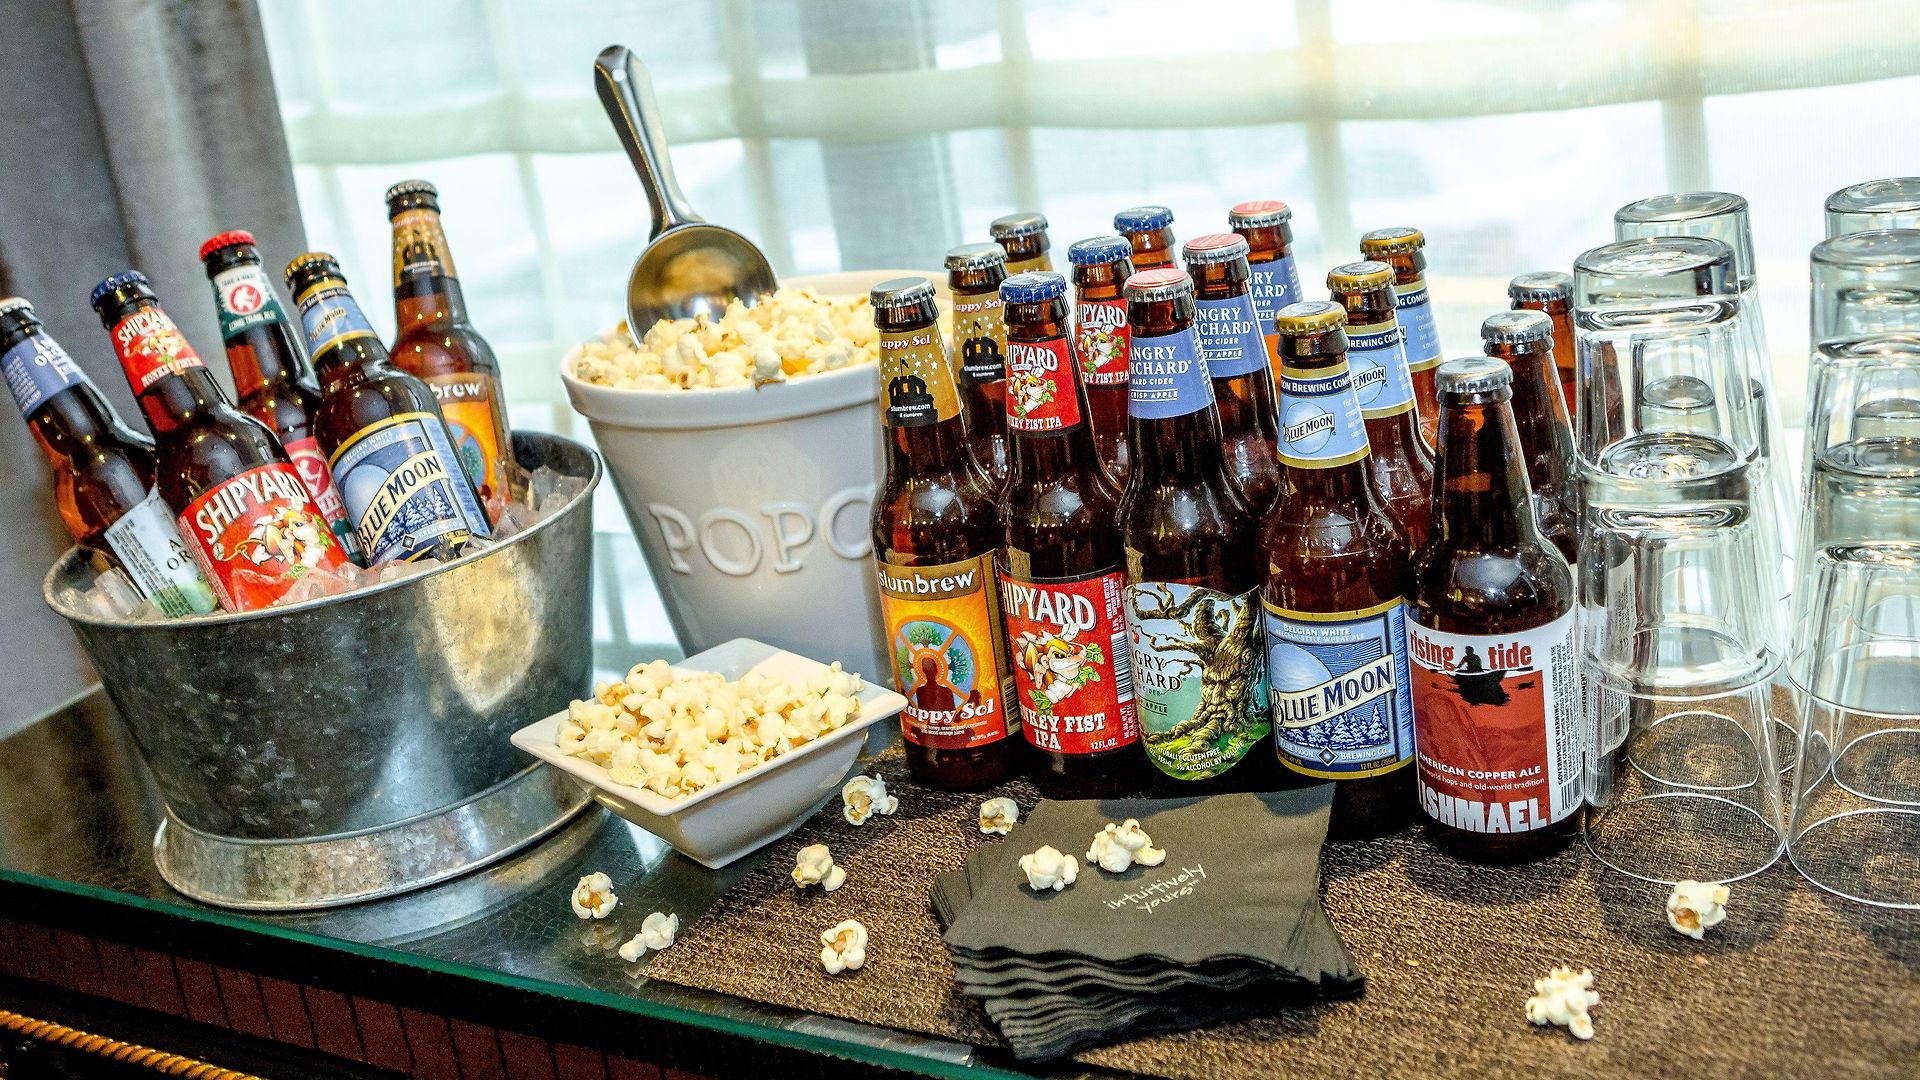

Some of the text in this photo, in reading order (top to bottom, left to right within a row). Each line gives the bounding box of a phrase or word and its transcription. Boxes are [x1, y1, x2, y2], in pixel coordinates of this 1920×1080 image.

[953, 303, 982, 313] appy
[880, 335, 930, 350] appy Sol
[1215, 337, 1239, 345] CIDER
[1217, 349, 1242, 358] APPLE
[1096, 372, 1113, 385] FIST
[1115, 370, 1130, 383] IPA
[1359, 369, 1385, 385] MOON
[1292, 382, 1332, 393] BREWING
[890, 403, 931, 412] slumbrew.com
[1026, 418, 1043, 430] FIST
[1045, 416, 1062, 429] IPA
[1284, 425, 1305, 442] BLUE
[1306, 415, 1333, 434] MOON
[196, 469, 312, 545] SHIPYARD
[357, 496, 391, 560] BLUE
[386, 455, 442, 506] MOON
[879, 569, 974, 595] slumbrew
[1283, 623, 1351, 636] BELGIAN WHITE
[1410, 629, 1532, 672] rising tide
[1272, 660, 1392, 727] BLUE MOON
[904, 706, 956, 725] appy
[960, 698, 995, 719] Sol
[1145, 702, 1168, 714] APPLE
[1065, 712, 1106, 734] FIST
[1034, 729, 1062, 751] IPA
[1182, 752, 1206, 762] GLUTEN
[1206, 746, 1222, 758] FREE
[1185, 760, 1215, 771] ALCOHOL
[1214, 757, 1222, 765] BY
[1222, 741, 1245, 760] VOLUME
[1340, 748, 1376, 760] BREWING
[1420, 751, 1541, 780] AMERICAN COPPER ALE
[1442, 776, 1545, 791] hops and old-world tradition
[1420, 780, 1547, 833] ISHMAEL
[1103, 864, 1206, 909] intuitively
